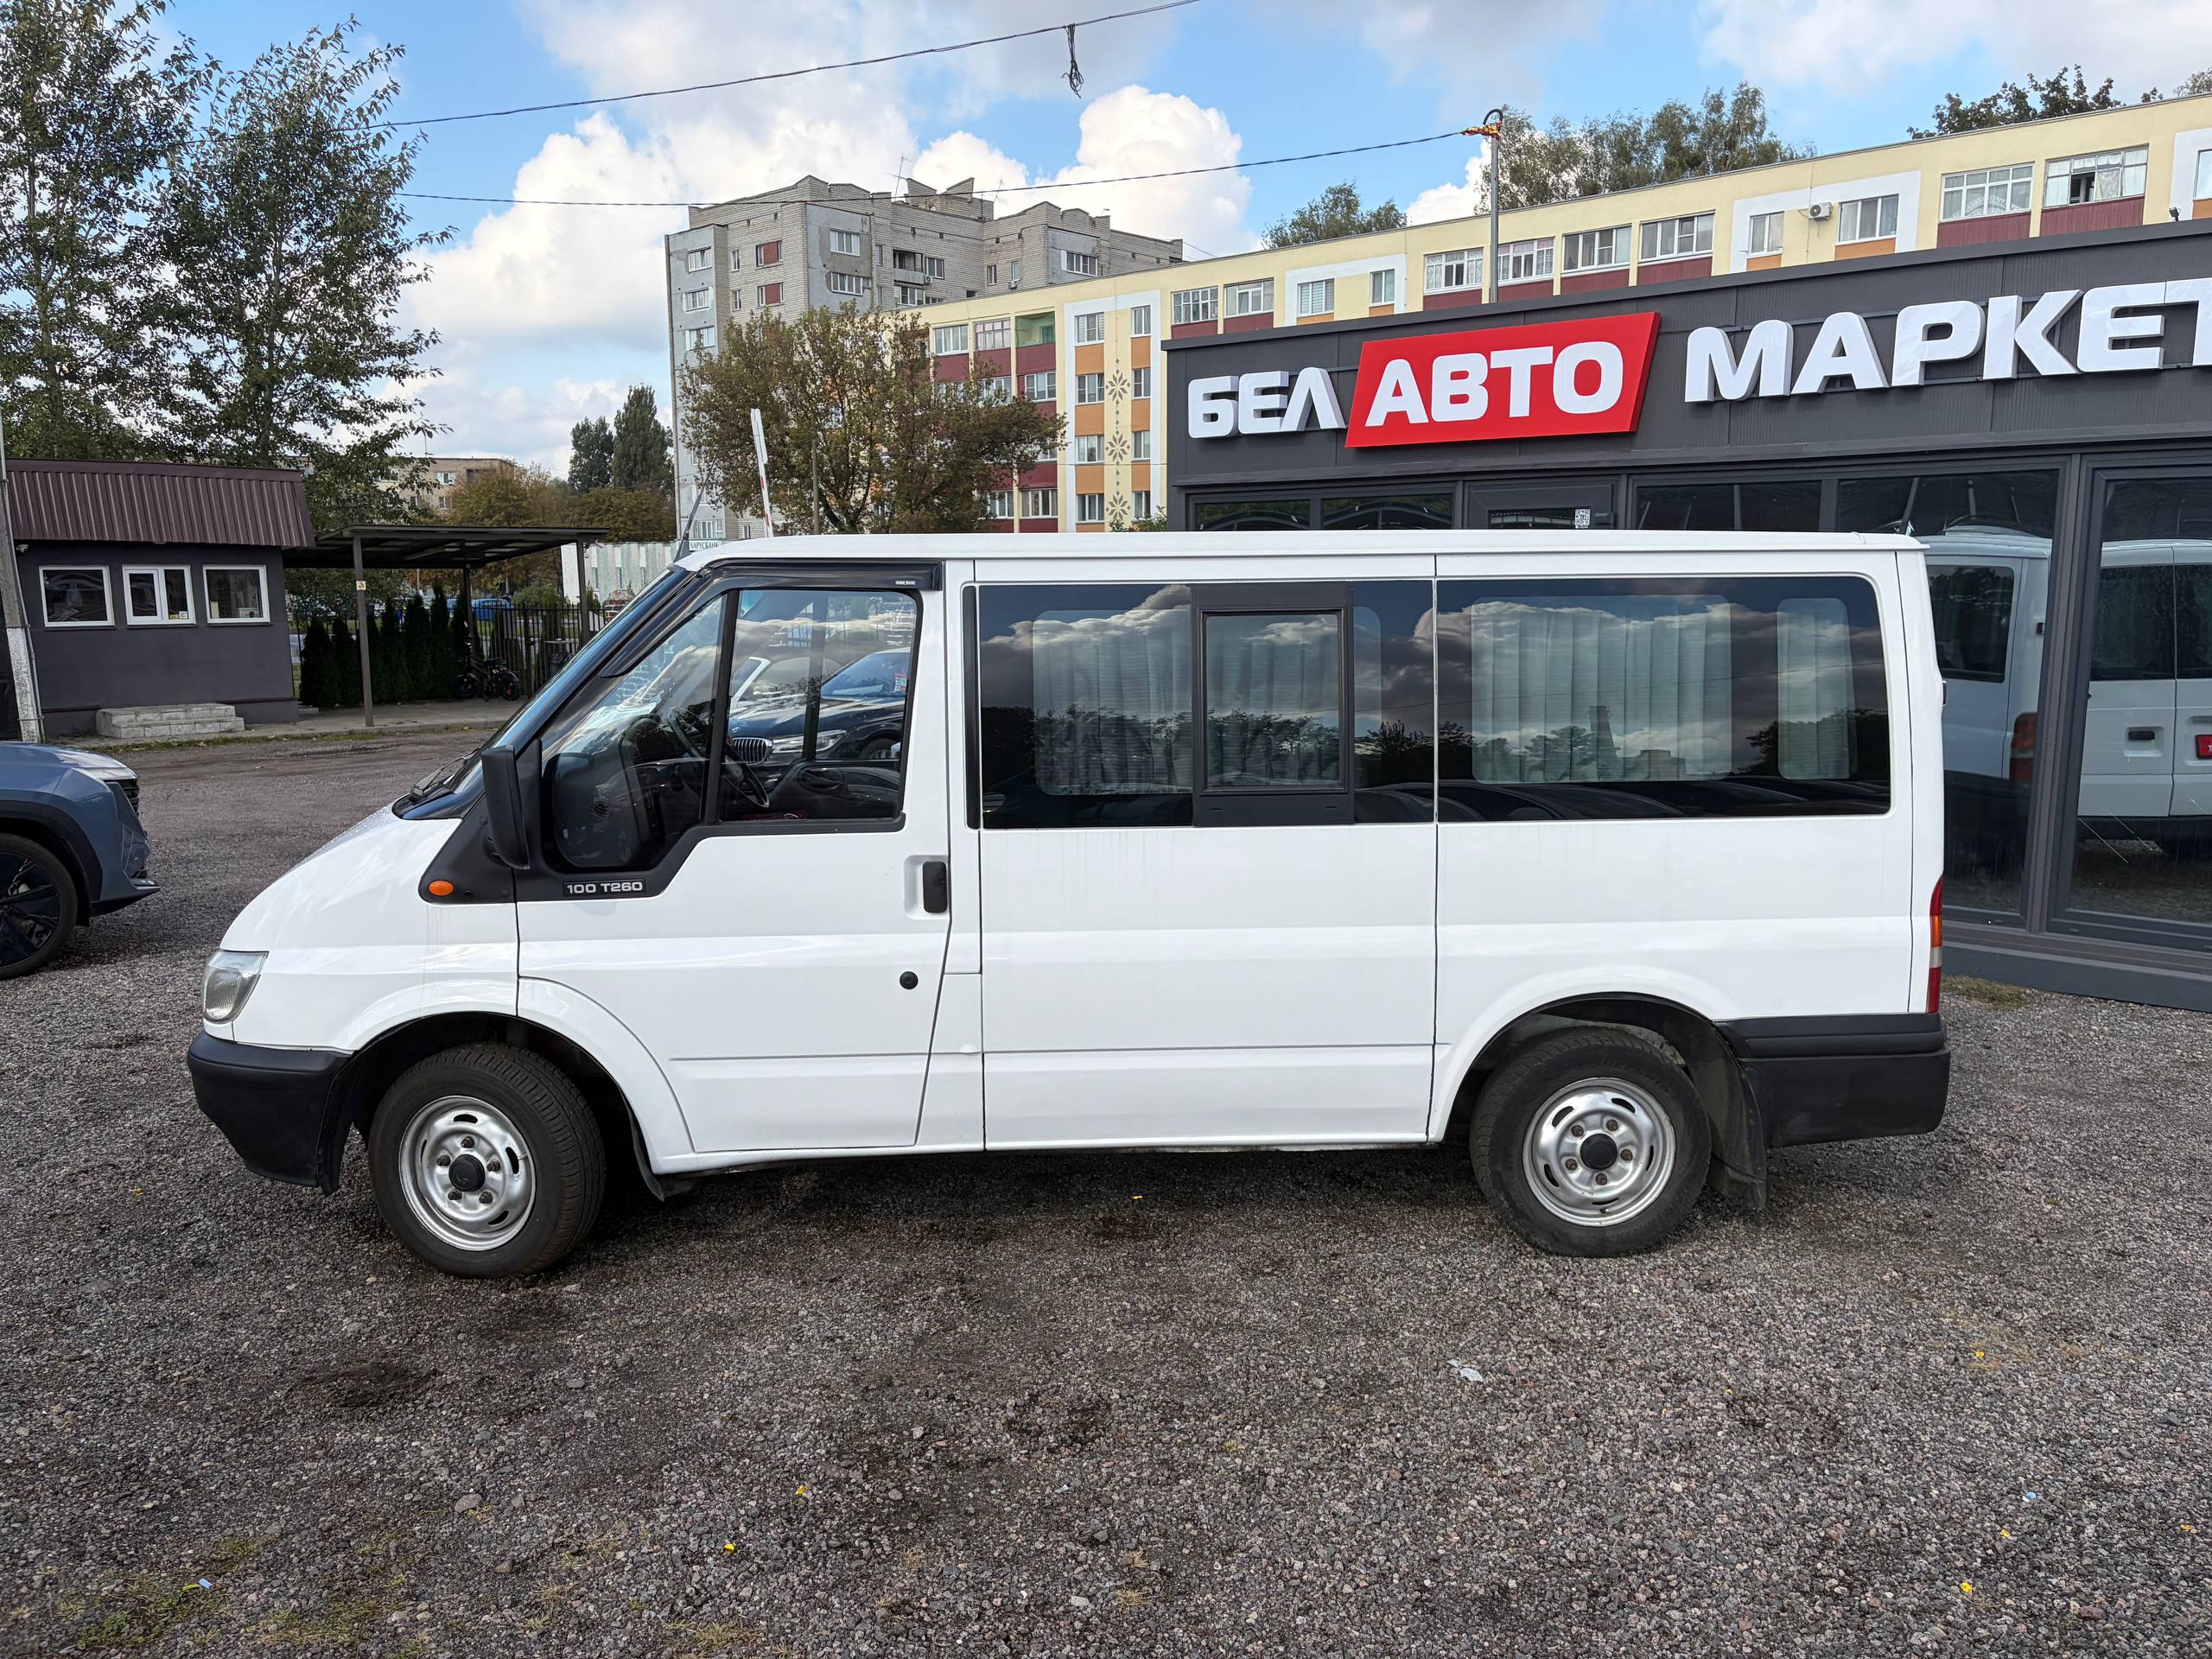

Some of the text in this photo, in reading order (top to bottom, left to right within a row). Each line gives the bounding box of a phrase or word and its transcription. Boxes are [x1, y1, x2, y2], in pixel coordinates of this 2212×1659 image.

[1188, 367, 1346, 439] БЕЛ
[1364, 340, 1624, 427] АВТО
[567, 881, 643, 893] 100 T260
